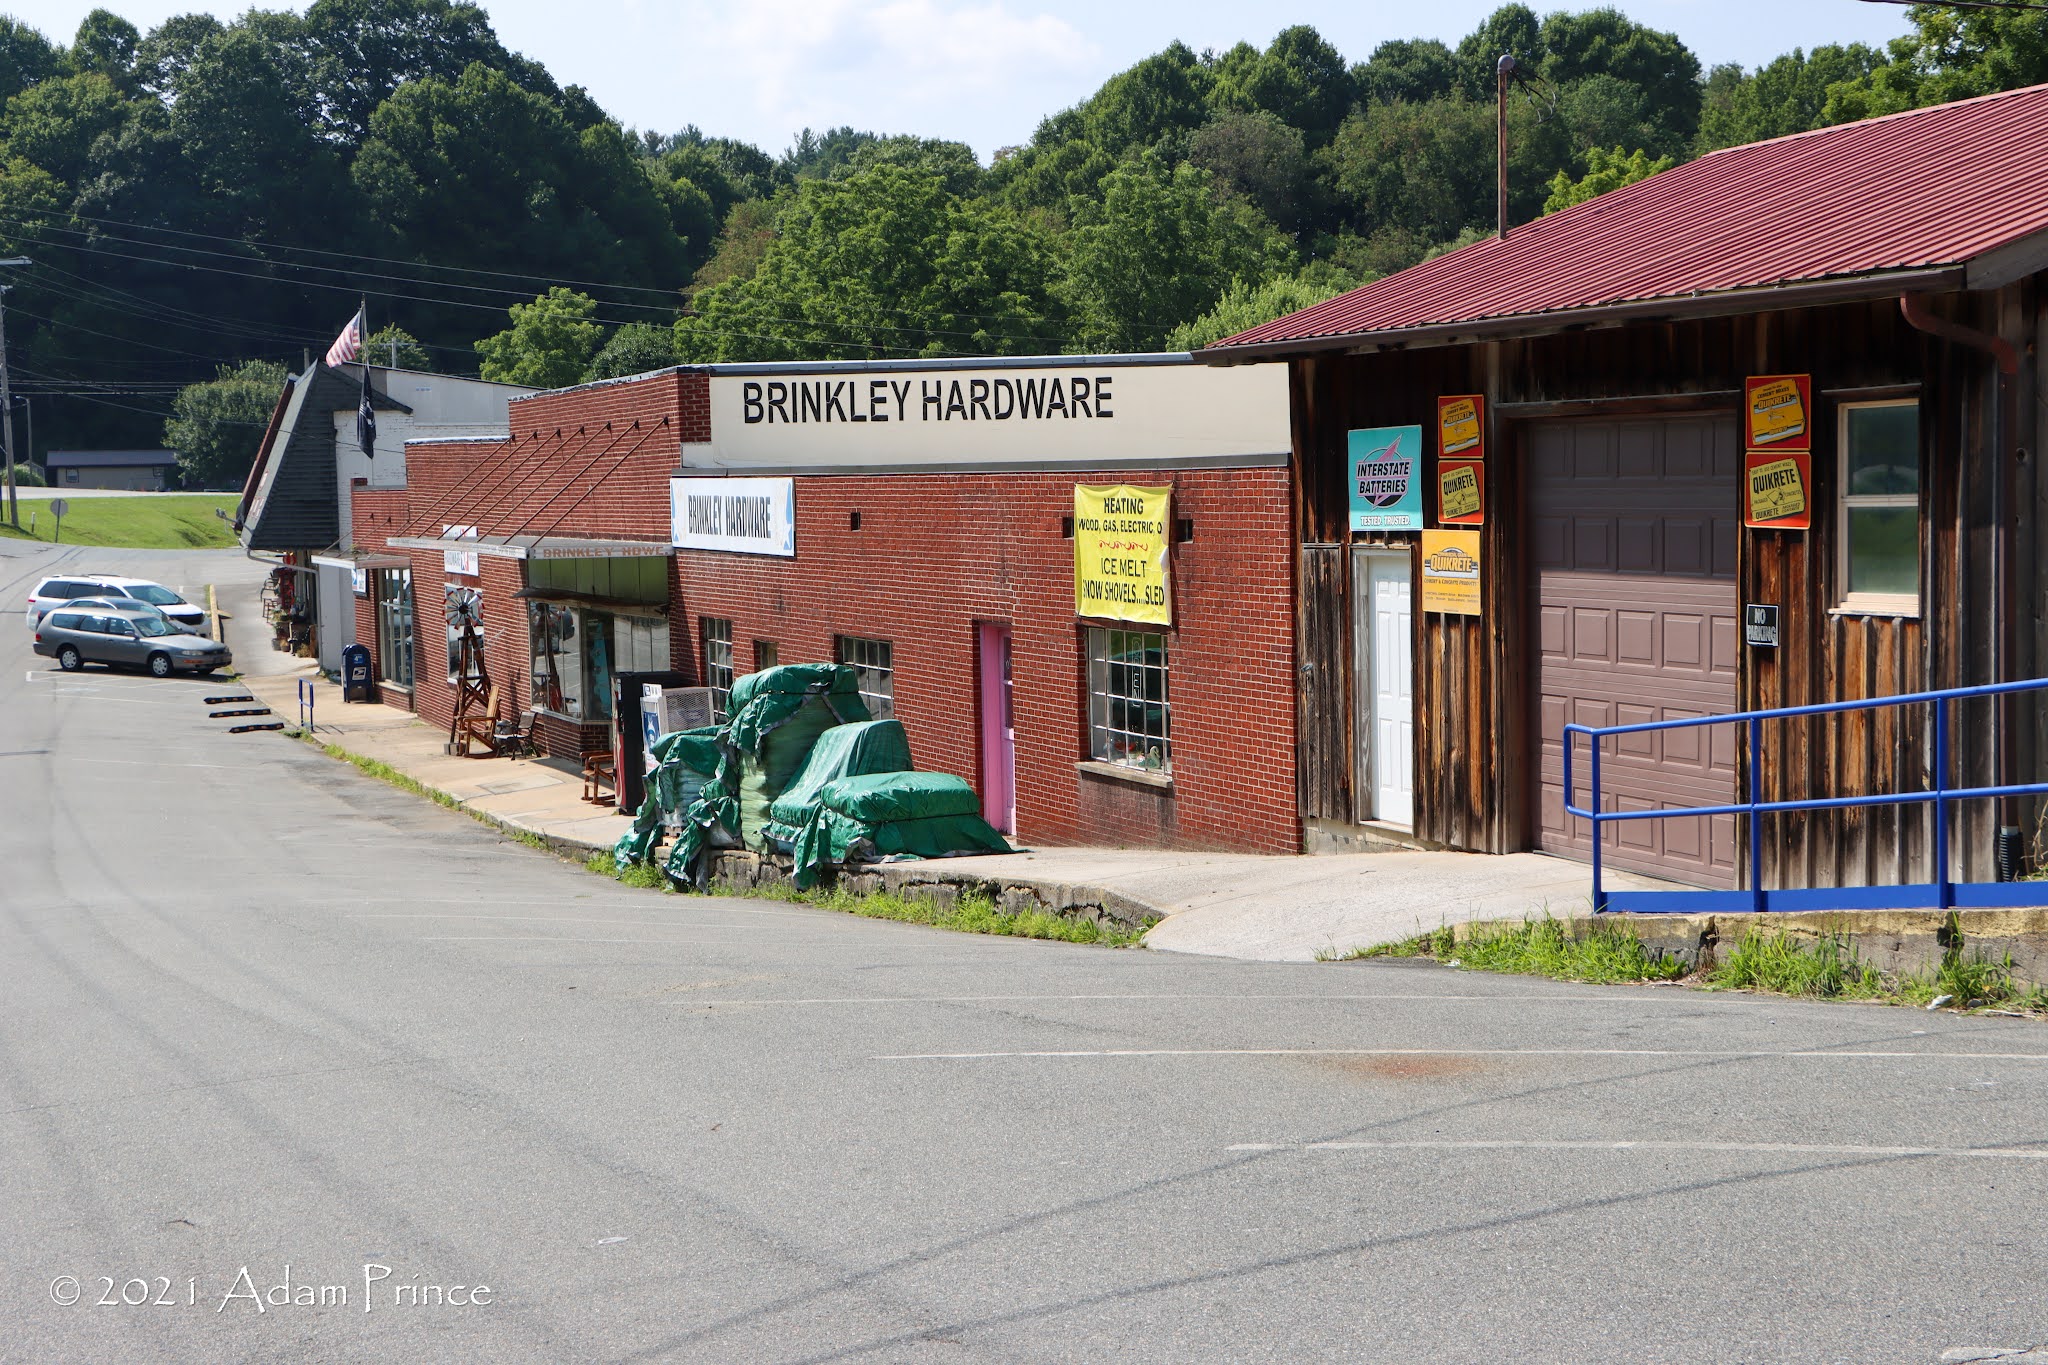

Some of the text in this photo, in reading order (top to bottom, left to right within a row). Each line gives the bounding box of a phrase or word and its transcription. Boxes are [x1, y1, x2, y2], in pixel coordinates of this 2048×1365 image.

[743, 376, 1114, 424] BRINKLEY HARDWARE
[1758, 393, 1792, 410] QUIKRETE
[1357, 461, 1410, 477] INTERSTATE
[1359, 479, 1406, 494] BATTERIES
[1443, 474, 1474, 496] QUIKRETE
[1752, 469, 1797, 494] QUIKRETE
[1103, 497, 1144, 515] HEATING
[1755, 507, 1779, 520] QUIKRETE
[688, 494, 771, 538] BRINKLEY HARDWARE
[1360, 515, 1411, 527] TESTED. TRUSTED.
[1103, 520, 1119, 535] GAS,
[543, 547, 614, 558] BRINKLEY
[1101, 557, 1147, 578] ICE MELT
[1430, 554, 1473, 573] QUIKRETE
[1754, 608, 1766, 624] NO
[1747, 625, 1777, 643] PARKING
